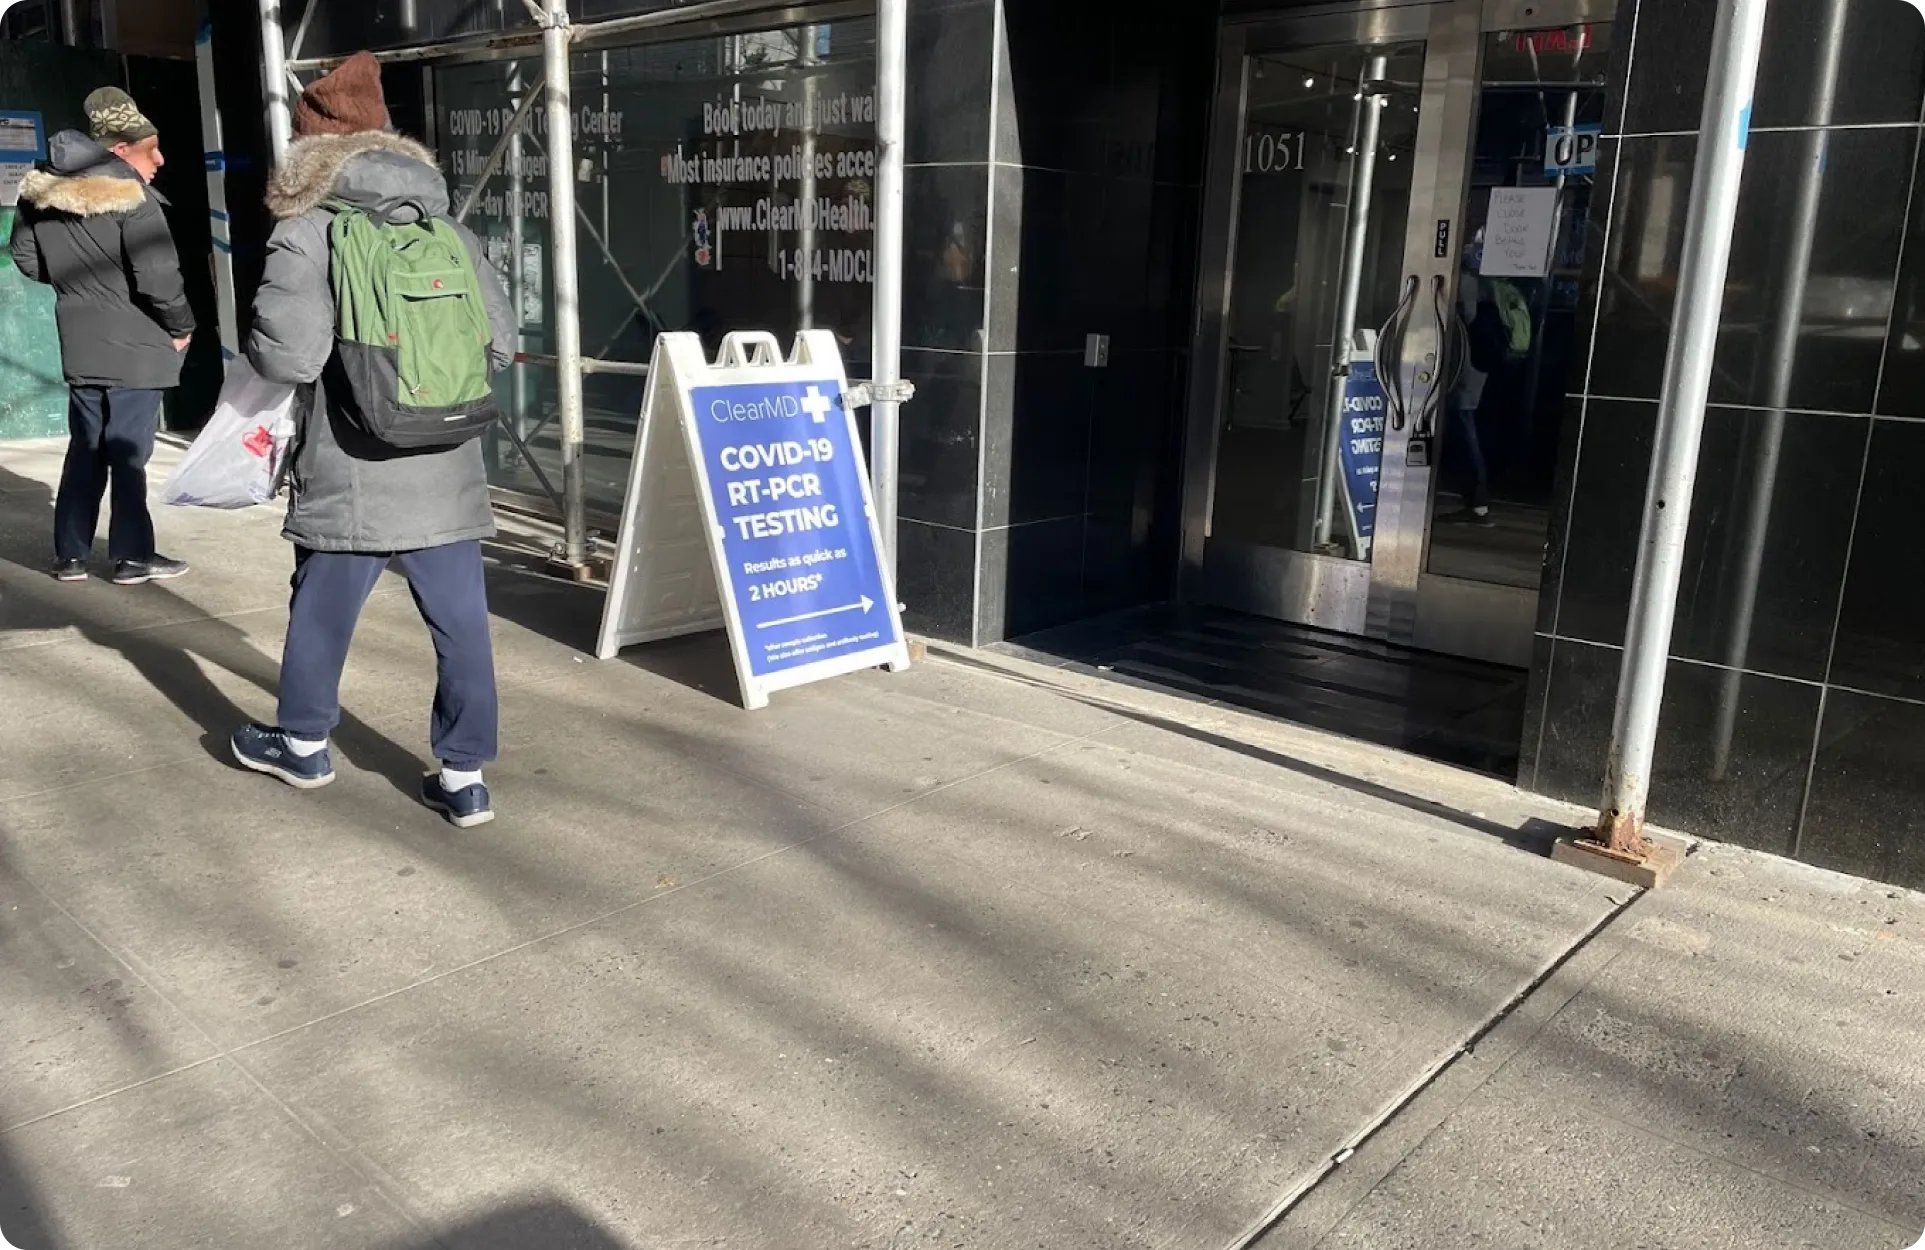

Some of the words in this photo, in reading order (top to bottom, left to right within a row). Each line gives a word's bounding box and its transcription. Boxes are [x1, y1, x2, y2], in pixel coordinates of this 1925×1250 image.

[450, 109, 499, 136] COVID-19
[502, 107, 533, 136] Rid
[704, 97, 740, 135] Book
[742, 96, 780, 138] today
[816, 91, 847, 136] just
[452, 150, 464, 176] 15
[466, 149, 502, 176] Mine
[504, 148, 546, 183] Aigen
[1244, 131, 1305, 172] 1051
[1555, 134, 1600, 166] OP
[667, 154, 701, 184] Most
[702, 151, 771, 183] insurance
[453, 188, 503, 223] Sae-day
[1438, 222, 1448, 255] PULL
[711, 395, 799, 422] ClearMD
[720, 437, 833, 472] COVID-19
[727, 473, 822, 507] RT-PCR
[732, 504, 839, 540] TESTING
[743, 557, 787, 575] Results
[787, 556, 802, 568] as
[802, 549, 834, 566] quick
[834, 548, 847, 558] as
[748, 585, 761, 602] 2
